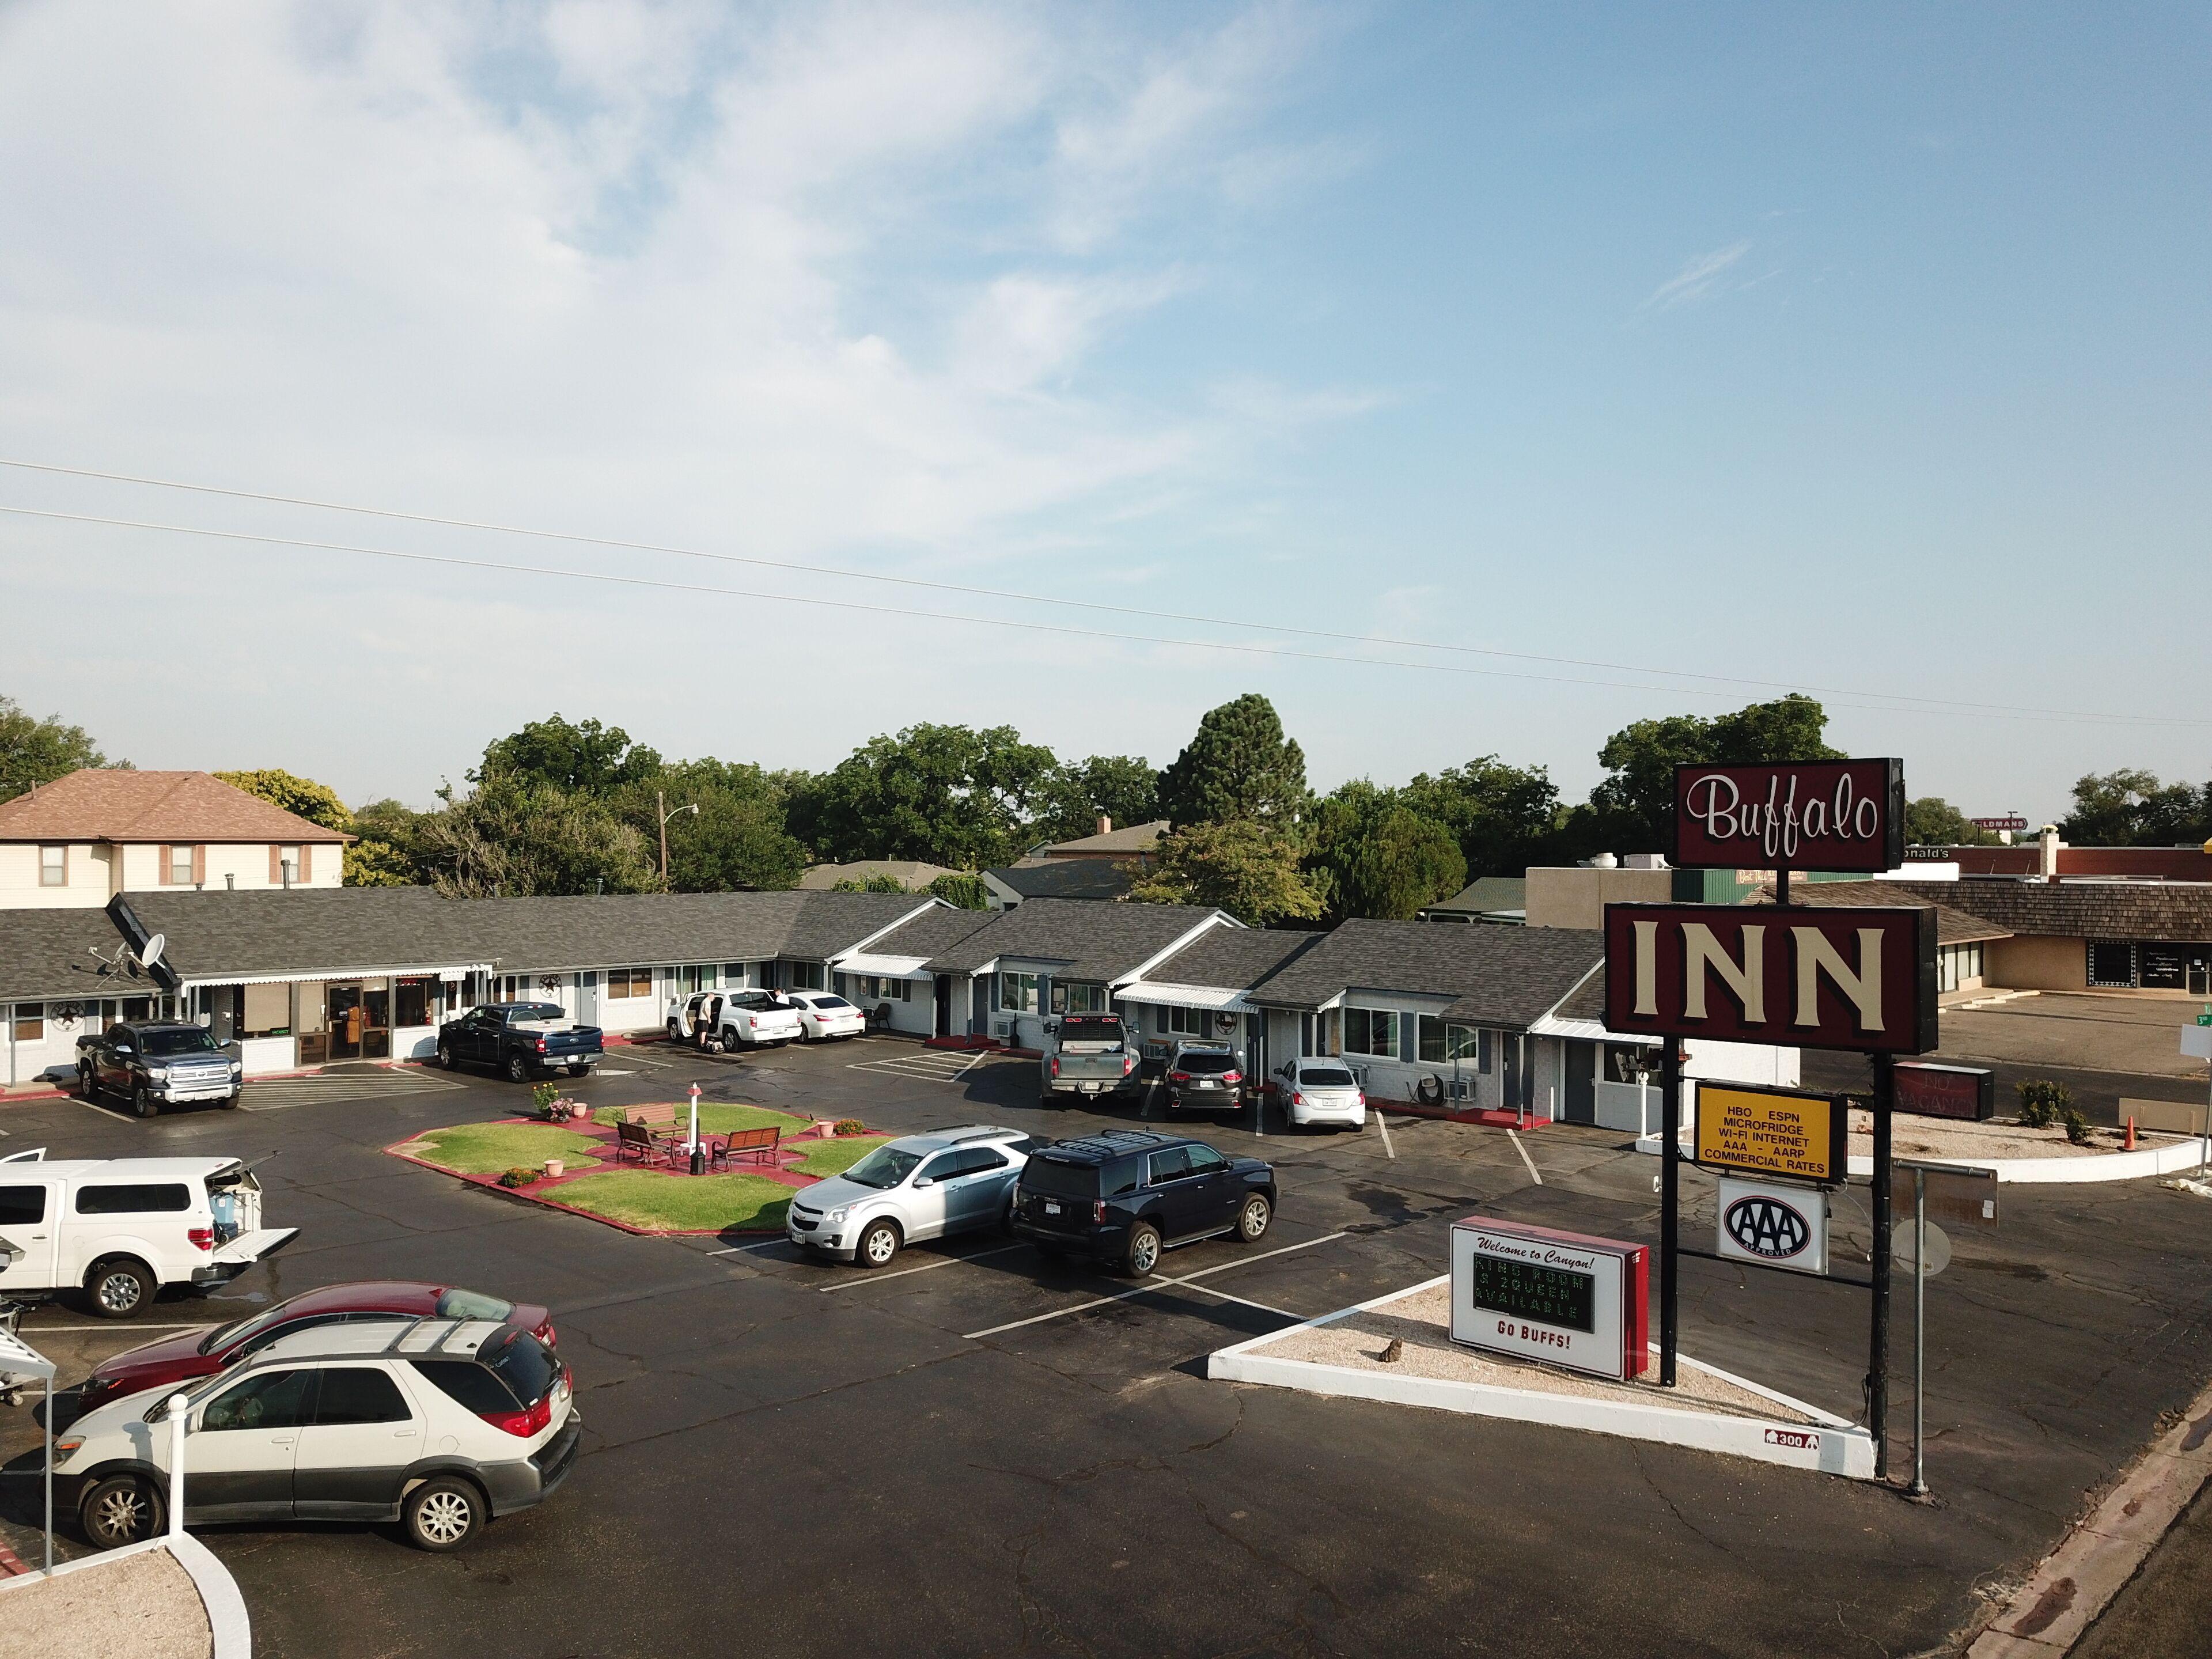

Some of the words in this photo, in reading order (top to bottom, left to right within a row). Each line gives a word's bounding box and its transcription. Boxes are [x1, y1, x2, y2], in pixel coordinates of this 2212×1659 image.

[1687, 772, 1877, 857] Buffalo
[1739, 870, 1753, 884] Best
[1633, 921, 1886, 1032] INN
[1922, 1074, 1949, 1091] NO
[1728, 1105, 1752, 1118] HBO
[1768, 1111, 1800, 1123] ESPN
[1724, 1117, 1804, 1136] MICROFRIDGE
[1718, 1127, 1748, 1140] WI-FI
[1752, 1132, 1810, 1148] INTERNET
[1723, 1140, 1748, 1152] AAA
[1772, 1146, 1805, 1159] AARP
[1705, 1148, 1782, 1168] COMMERCIAL
[1786, 1160, 1825, 1173] RATES
[1734, 1199, 1798, 1251] AAA
[1477, 1237, 1527, 1257] Welcome
[1529, 1249, 1541, 1259] to
[1544, 1250, 1596, 1270] Canyon!
[1744, 1242, 1791, 1256] APPROVED
[1498, 1320, 1514, 1336] GO
[1521, 1325, 1570, 1349] BUFFS!
[1779, 1433, 1802, 1448] 300
